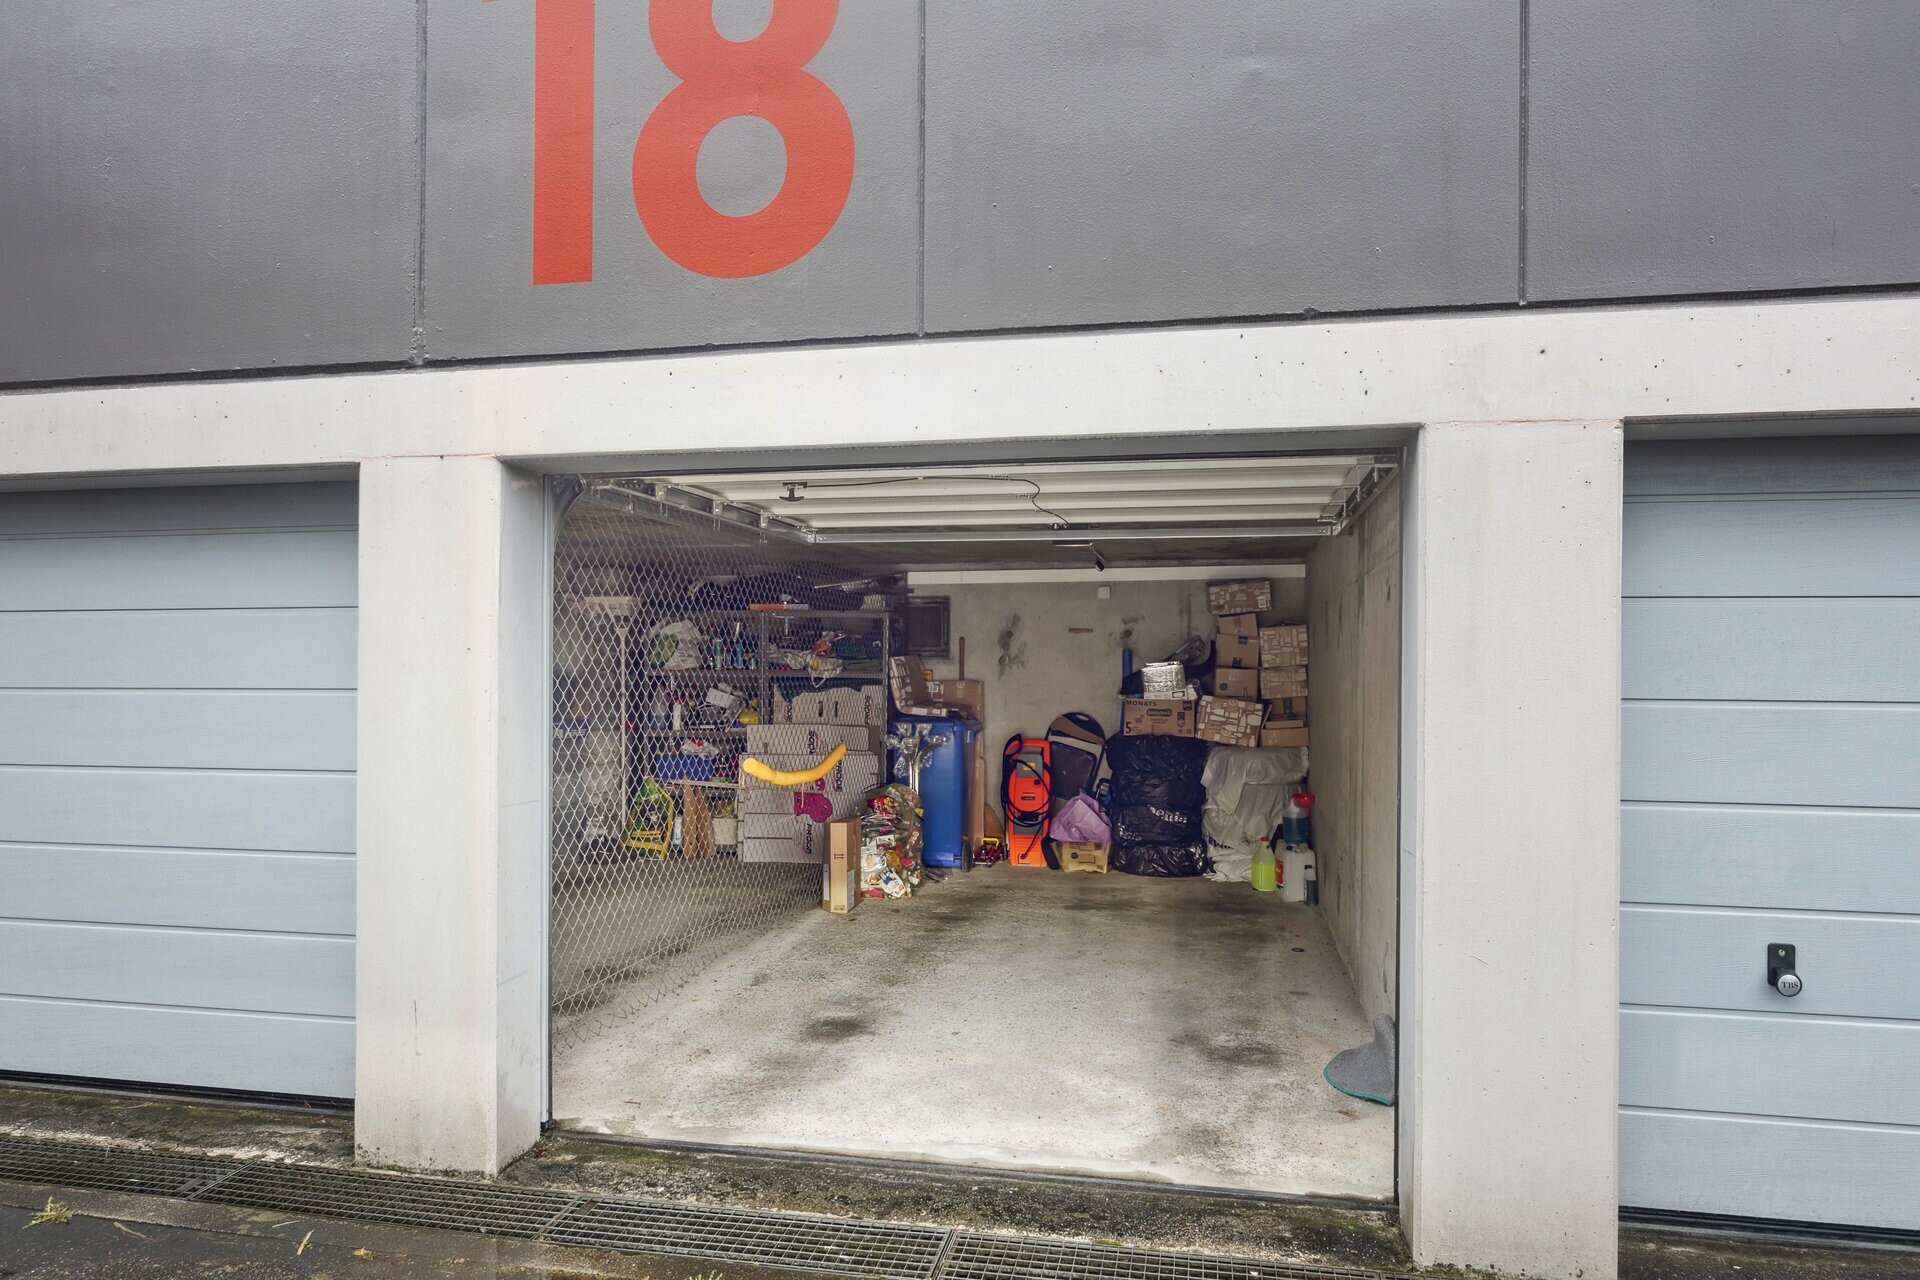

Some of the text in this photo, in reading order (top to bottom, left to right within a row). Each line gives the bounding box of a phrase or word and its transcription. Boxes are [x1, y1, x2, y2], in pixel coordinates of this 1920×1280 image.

[482, 0, 855, 285] 18
[1125, 721, 1132, 734] 5
[1781, 981, 1799, 989] TBS
